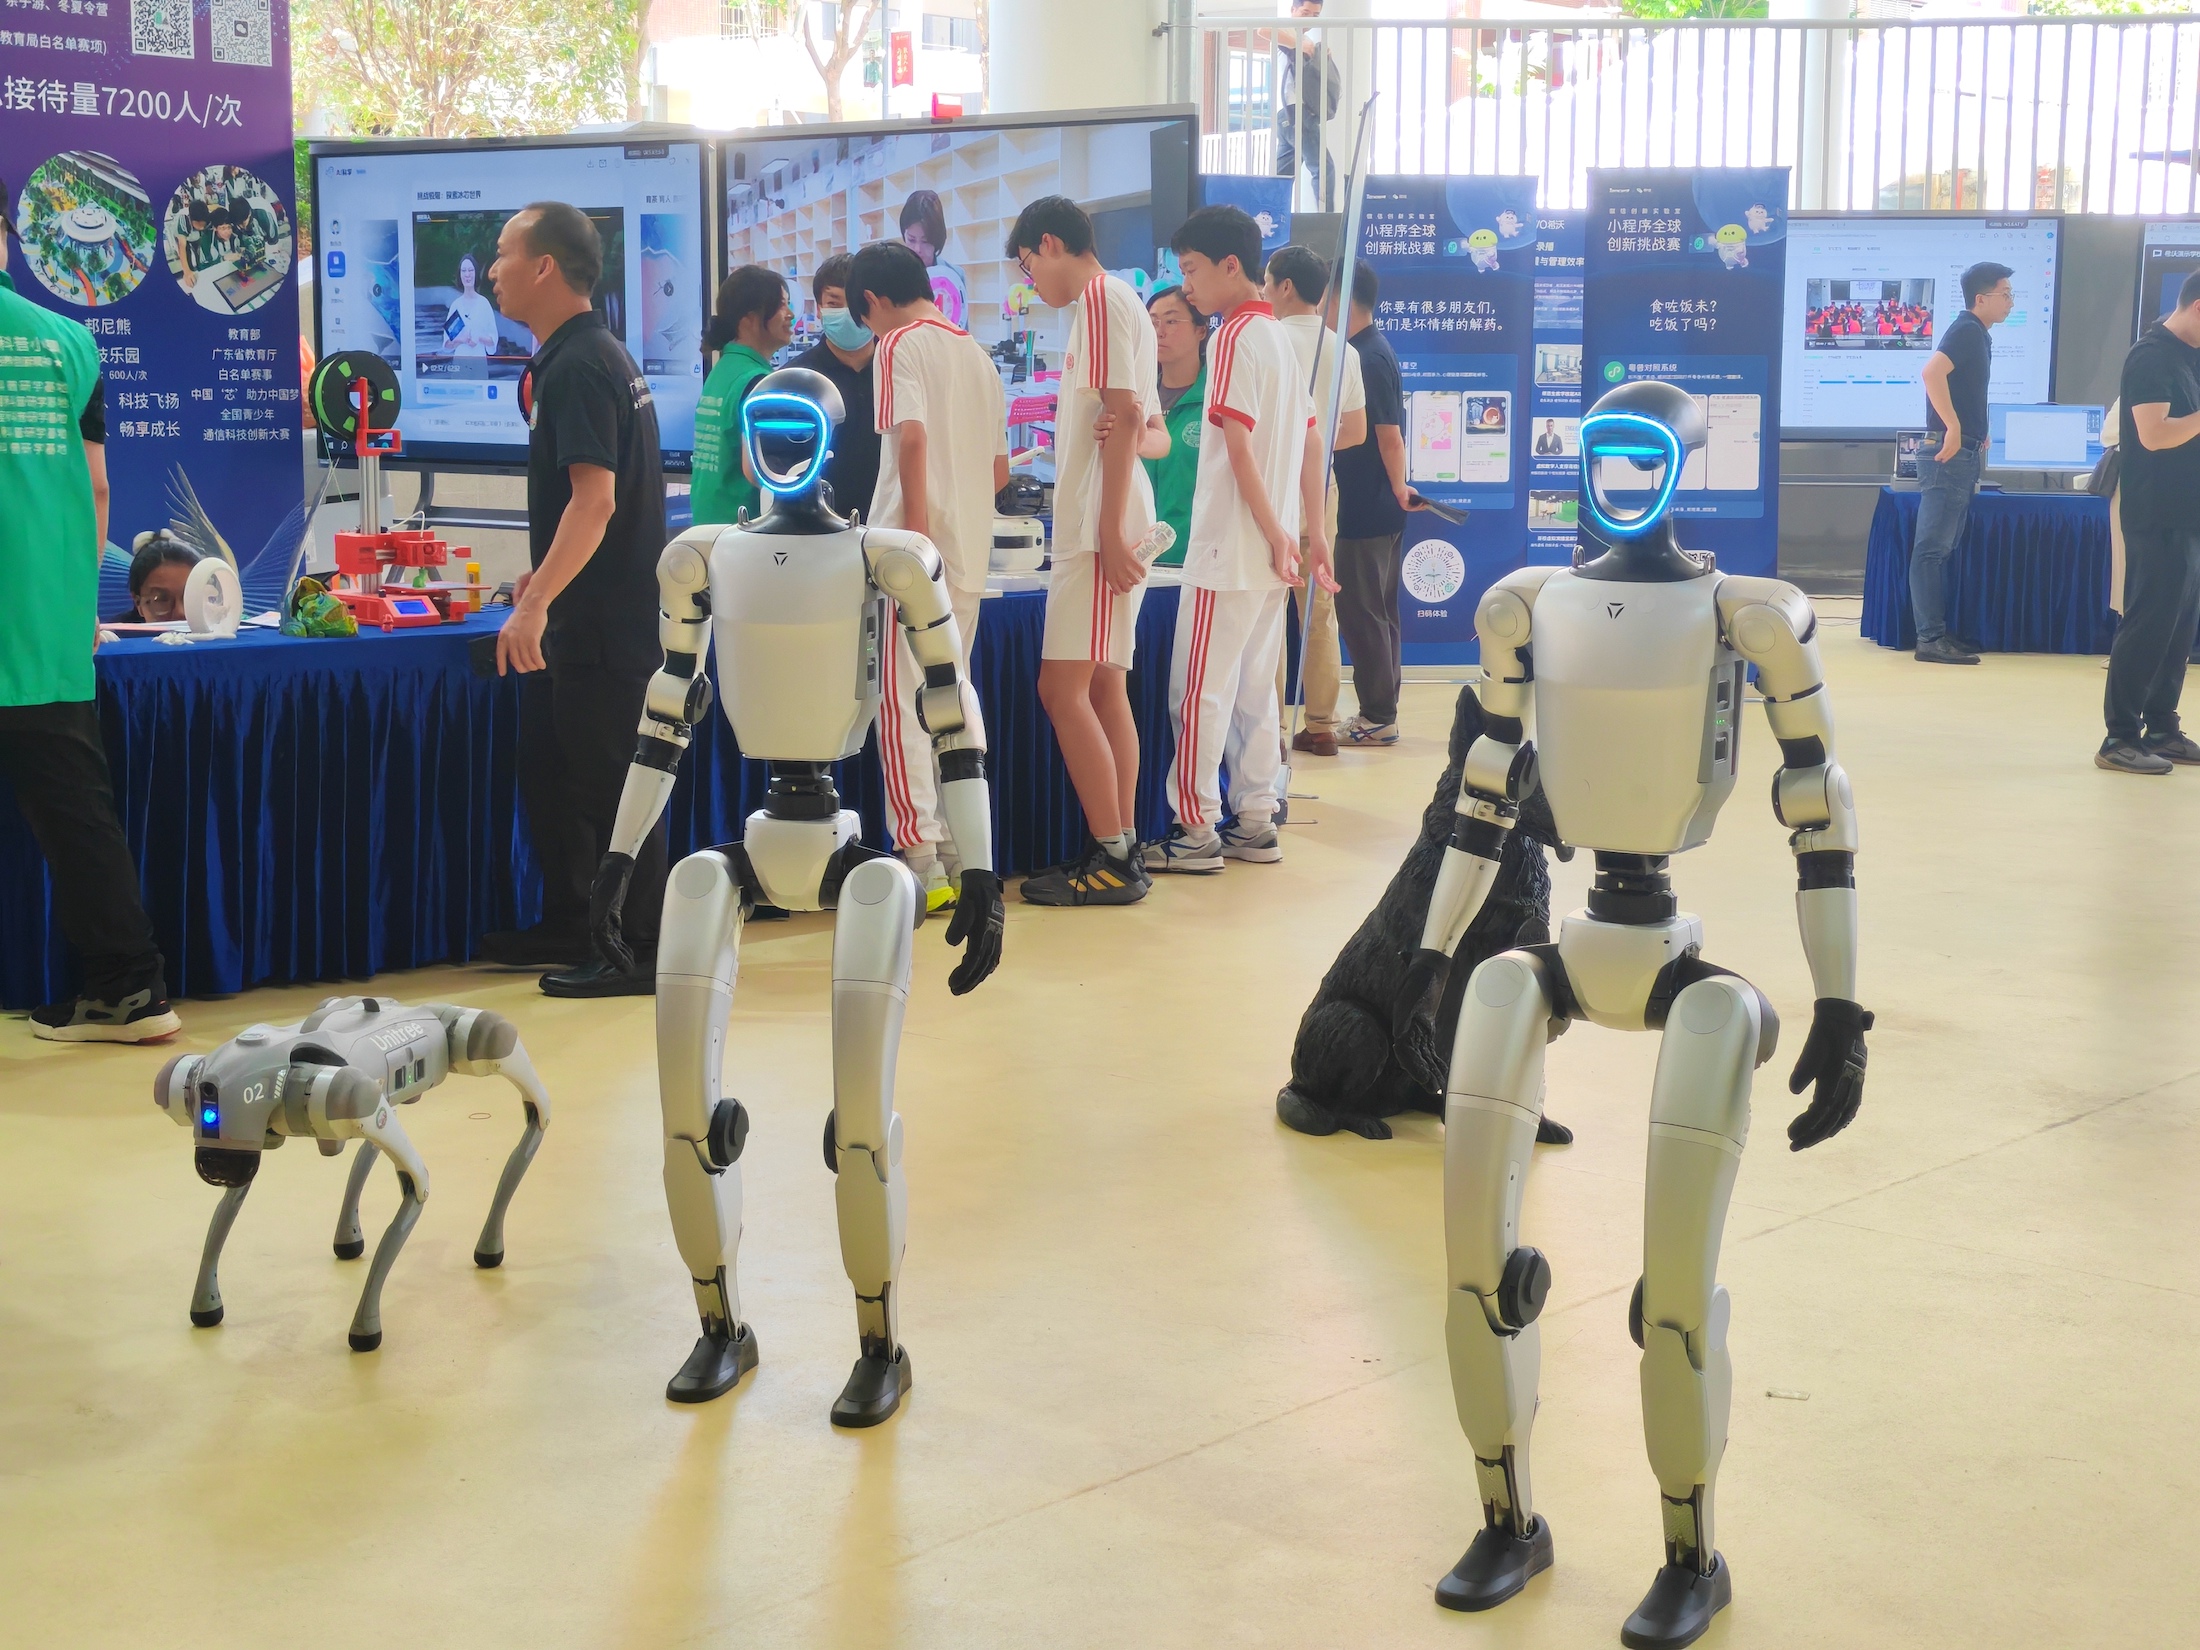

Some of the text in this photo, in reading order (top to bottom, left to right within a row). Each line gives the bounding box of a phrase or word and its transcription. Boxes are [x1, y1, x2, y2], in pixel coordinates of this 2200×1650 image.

[0, 75, 243, 128] 接待量7200人/次
[1365, 223, 1436, 238] 小程序全球
[1607, 218, 1682, 234] 小程序全球
[1365, 240, 1436, 255] 创新挑战赛
[1607, 236, 1681, 252] 创新挑战赛
[84, 317, 132, 335] 邦尼熊
[228, 328, 261, 341] 教育部
[212, 347, 278, 362] 广东省教育厅
[1398, 361, 1418, 370] 星空
[218, 368, 273, 381] 白名单赛事
[220, 408, 275, 421] 全国青少年
[203, 428, 290, 441] 通信科技创新大赛
[1417, 609, 1448, 618] 扫码体验
[369, 1022, 424, 1051] Unitree
[243, 1082, 265, 1105] 02
